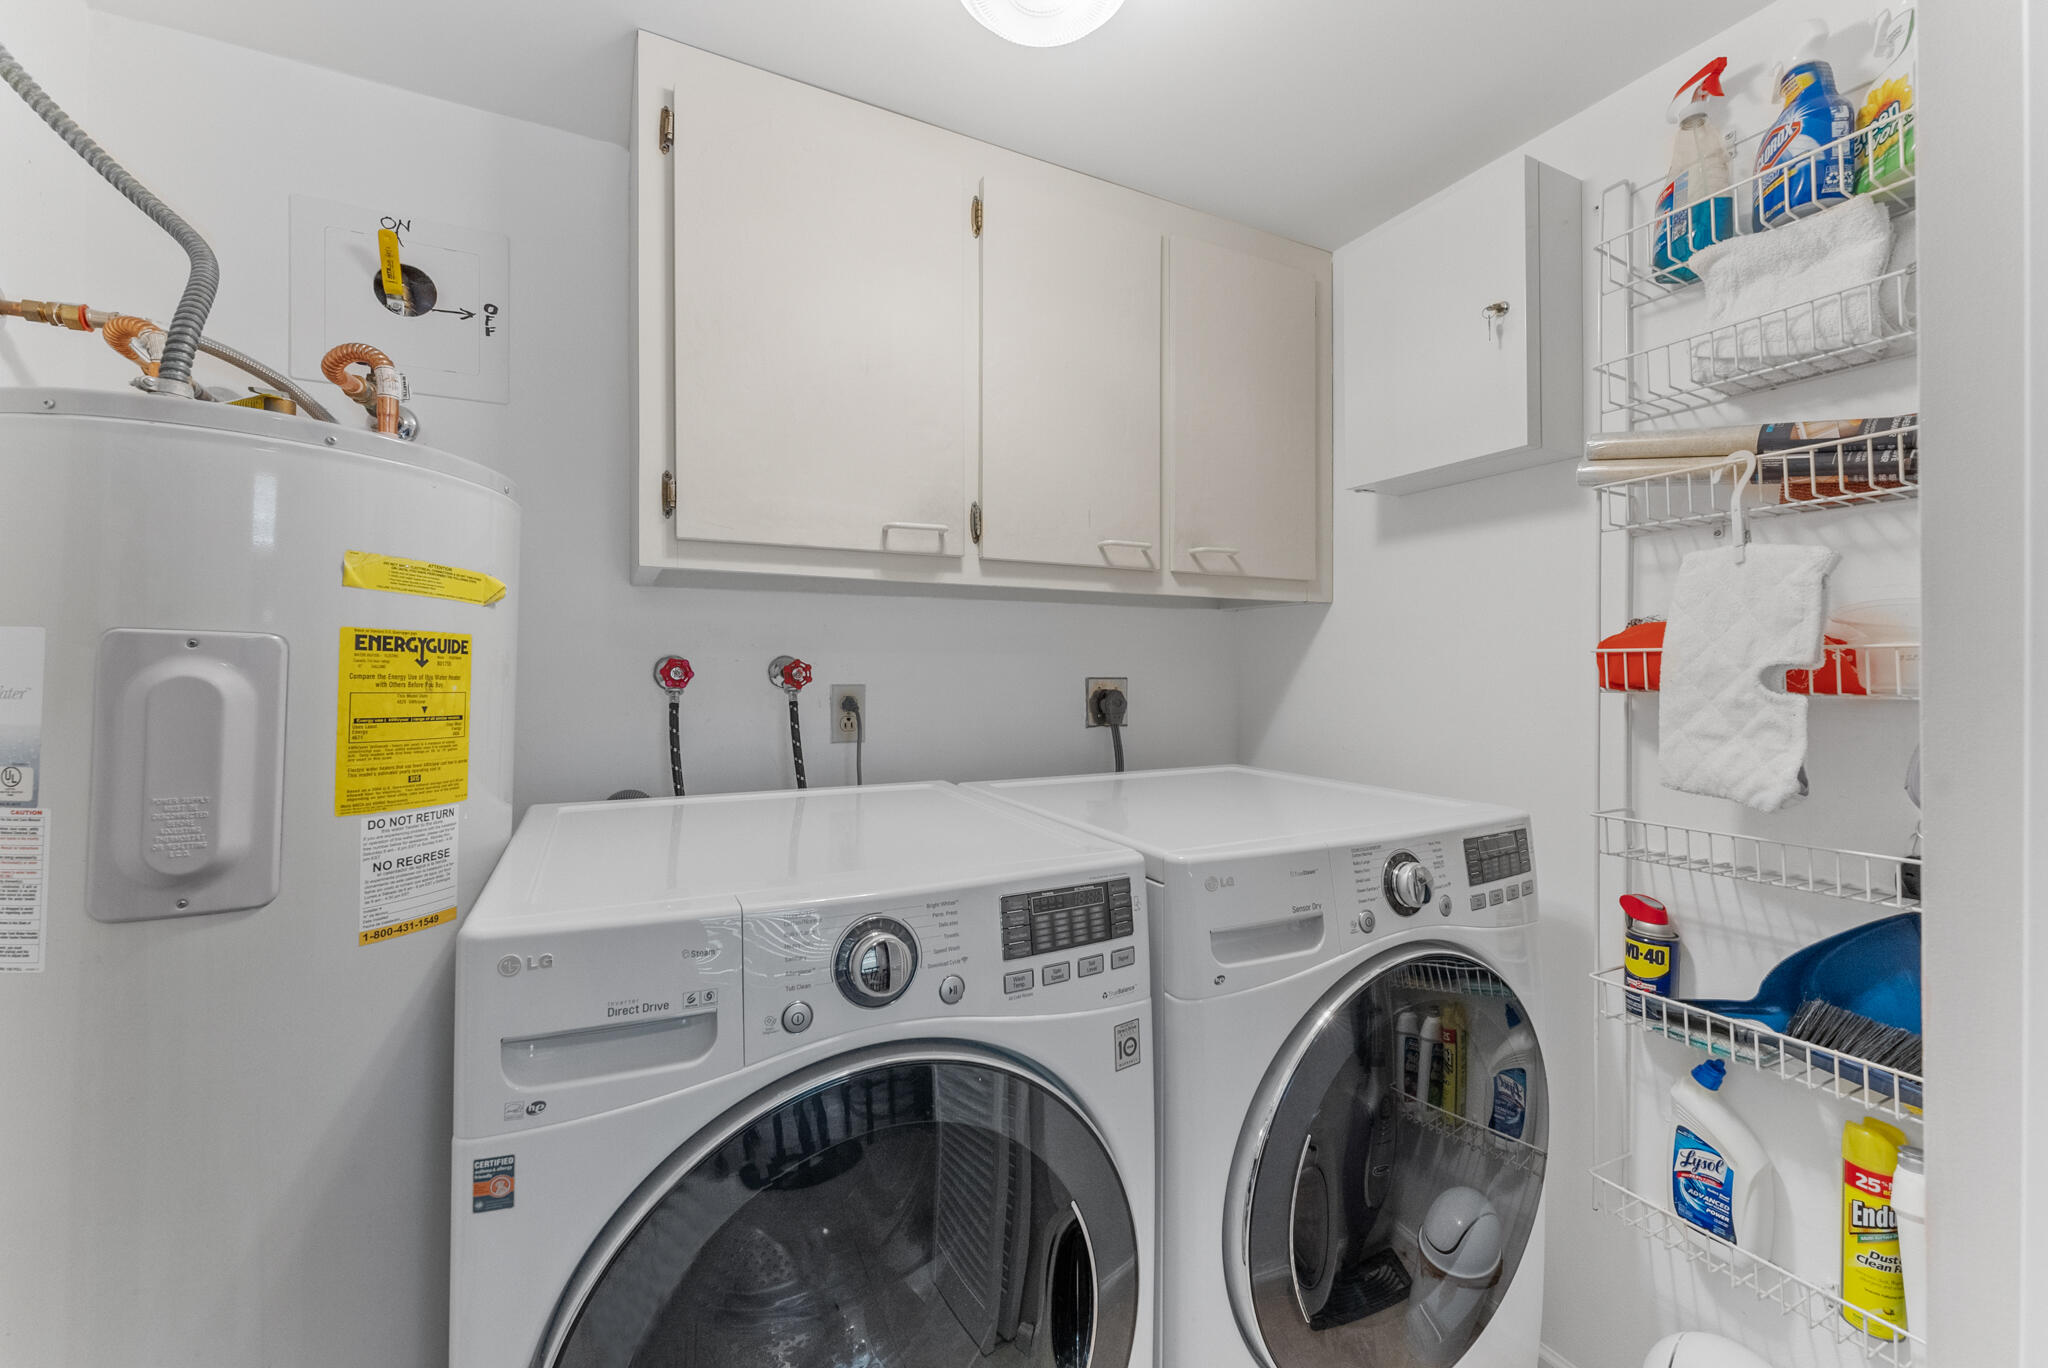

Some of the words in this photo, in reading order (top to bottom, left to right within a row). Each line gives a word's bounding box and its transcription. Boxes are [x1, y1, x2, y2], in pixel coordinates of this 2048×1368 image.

[380, 216, 411, 248] ON
[483, 303, 499, 337] OFF
[355, 634, 469, 662] ENERGYGUIDE
[349, 672, 376, 682] Compare
[388, 673, 406, 682] Energy
[367, 819, 386, 831] DO
[389, 815, 413, 828] NOT
[416, 808, 455, 824] RETURN
[372, 861, 393, 873] NO
[396, 848, 451, 869] REGRESE
[1219, 876, 1235, 888] LG
[1292, 905, 1311, 914] Sensor
[1311, 902, 1322, 911] Dry
[362, 914, 440, 942] 1-800-431-1549
[527, 953, 553, 971] LG
[785, 984, 796, 992] Tub
[796, 983, 812, 991] Clean
[607, 1005, 640, 1018] Direct
[642, 1002, 669, 1013] Drive
[1118, 1037, 1137, 1060] 10
[474, 1156, 514, 1169] CERTIFIED
[1680, 1150, 1724, 1175] Lysol
[1687, 1188, 1730, 1211] ADVANCED
[1705, 1208, 1730, 1223] POWER
[1856, 1254, 1892, 1273] Clean
[1869, 1250, 1898, 1265] Dust
